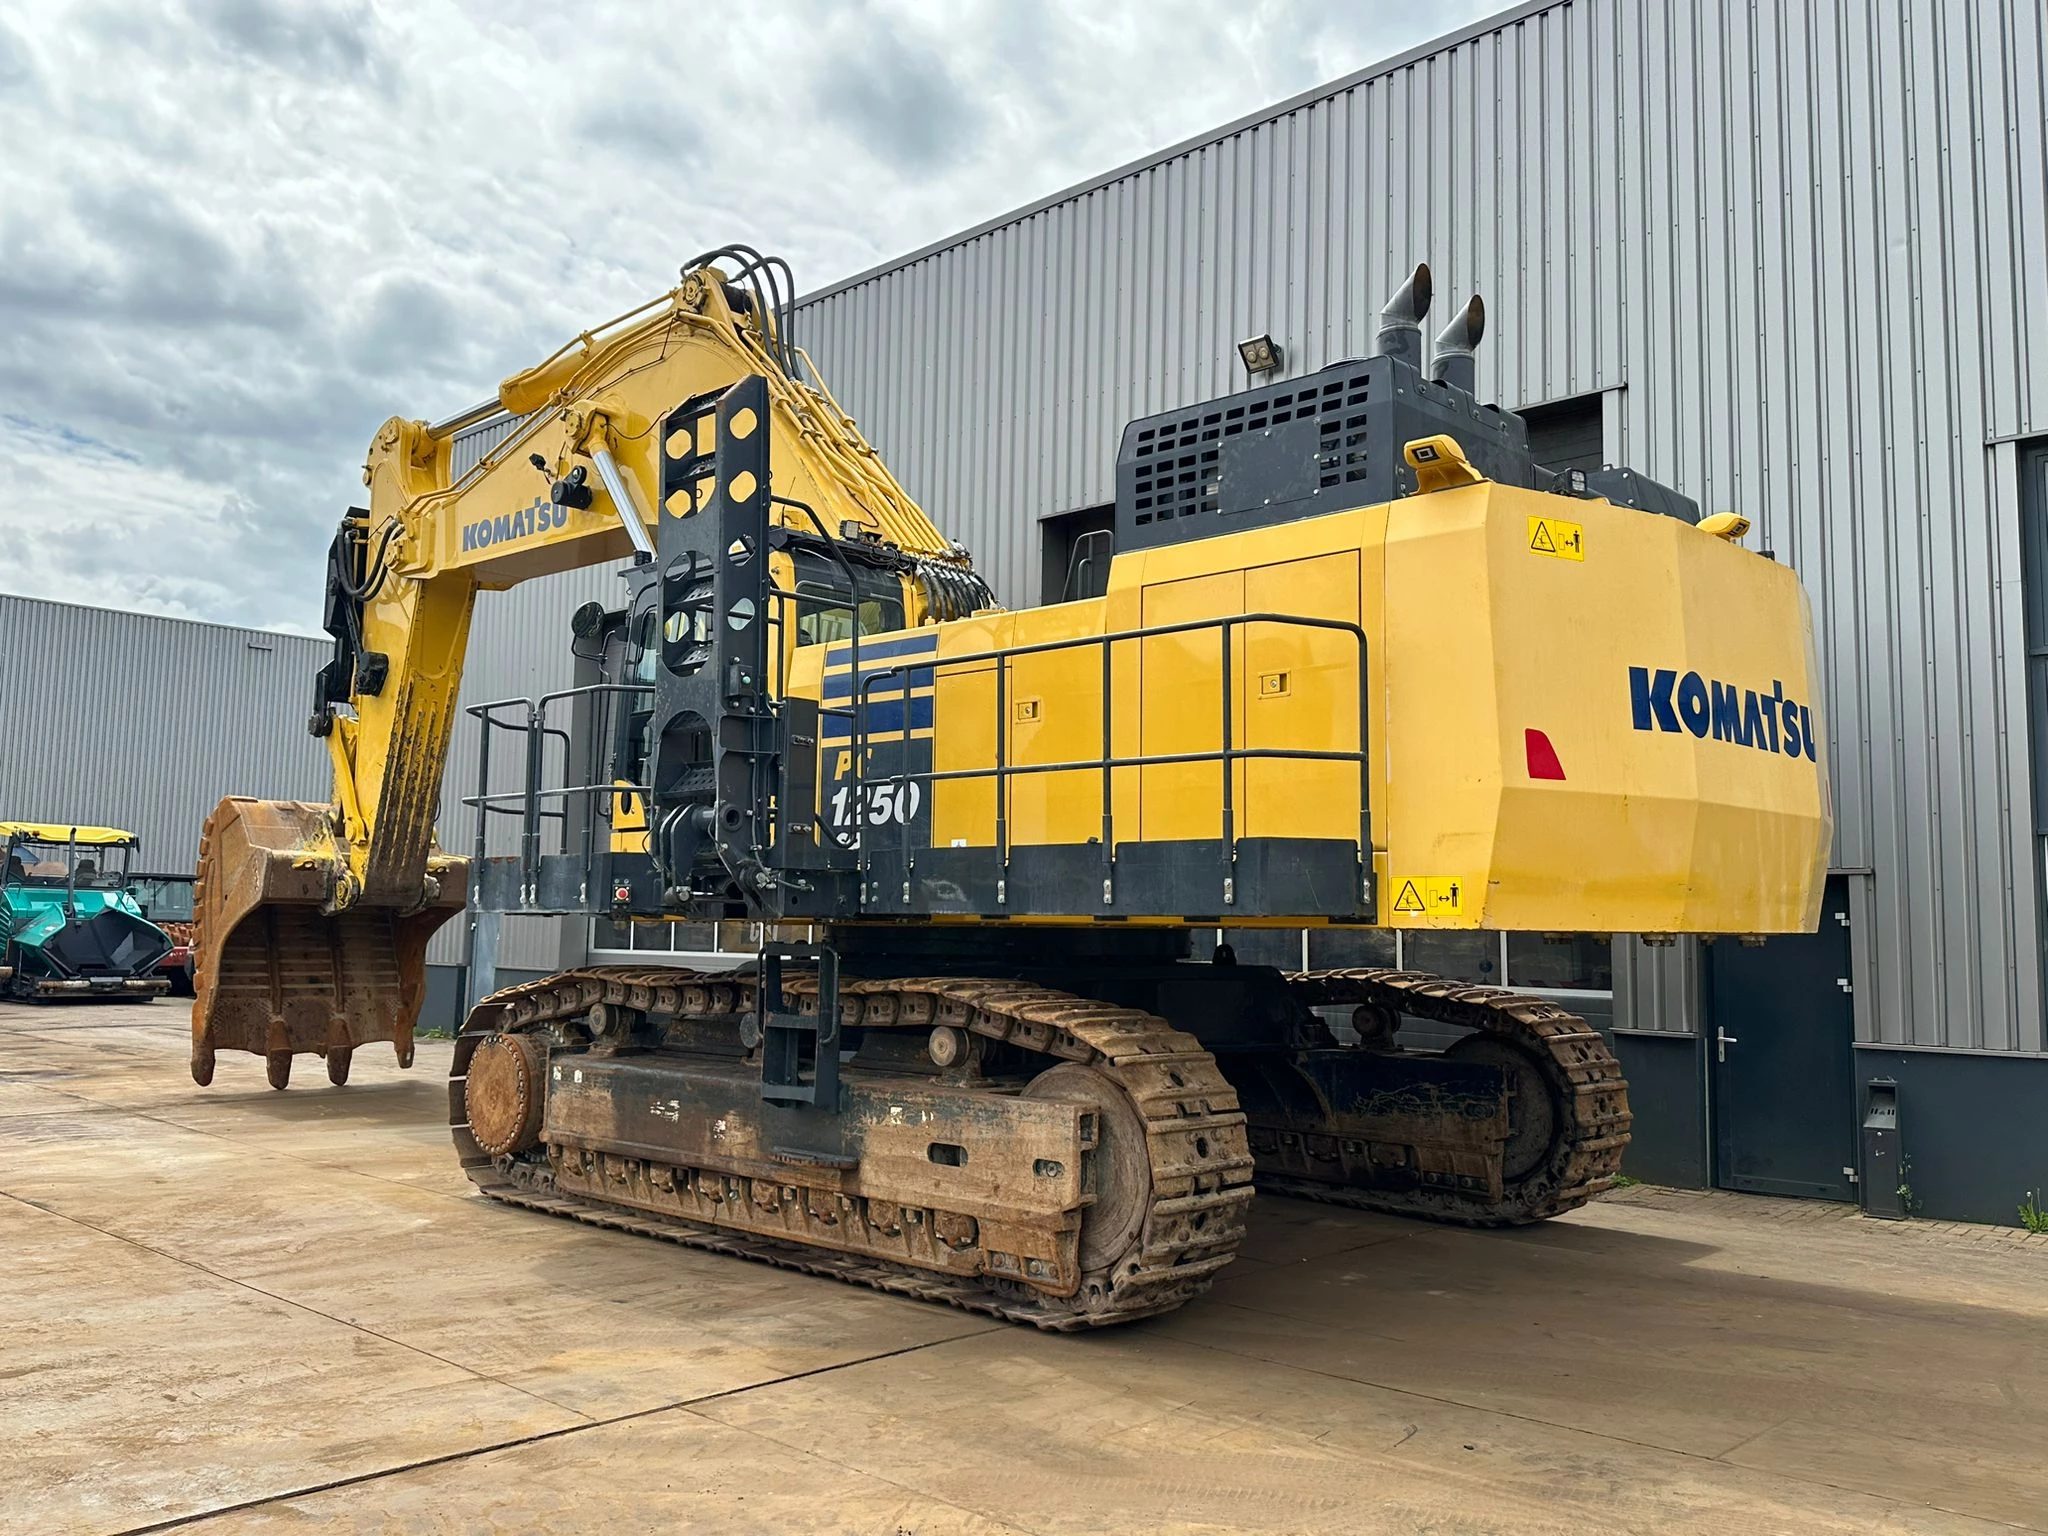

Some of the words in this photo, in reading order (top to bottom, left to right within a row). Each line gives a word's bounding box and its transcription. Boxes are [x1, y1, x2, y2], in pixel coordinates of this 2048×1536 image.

[462, 496, 568, 552] KOMATSU
[1628, 666, 1817, 763] KOMATSU
[831, 781, 920, 827] 1250
